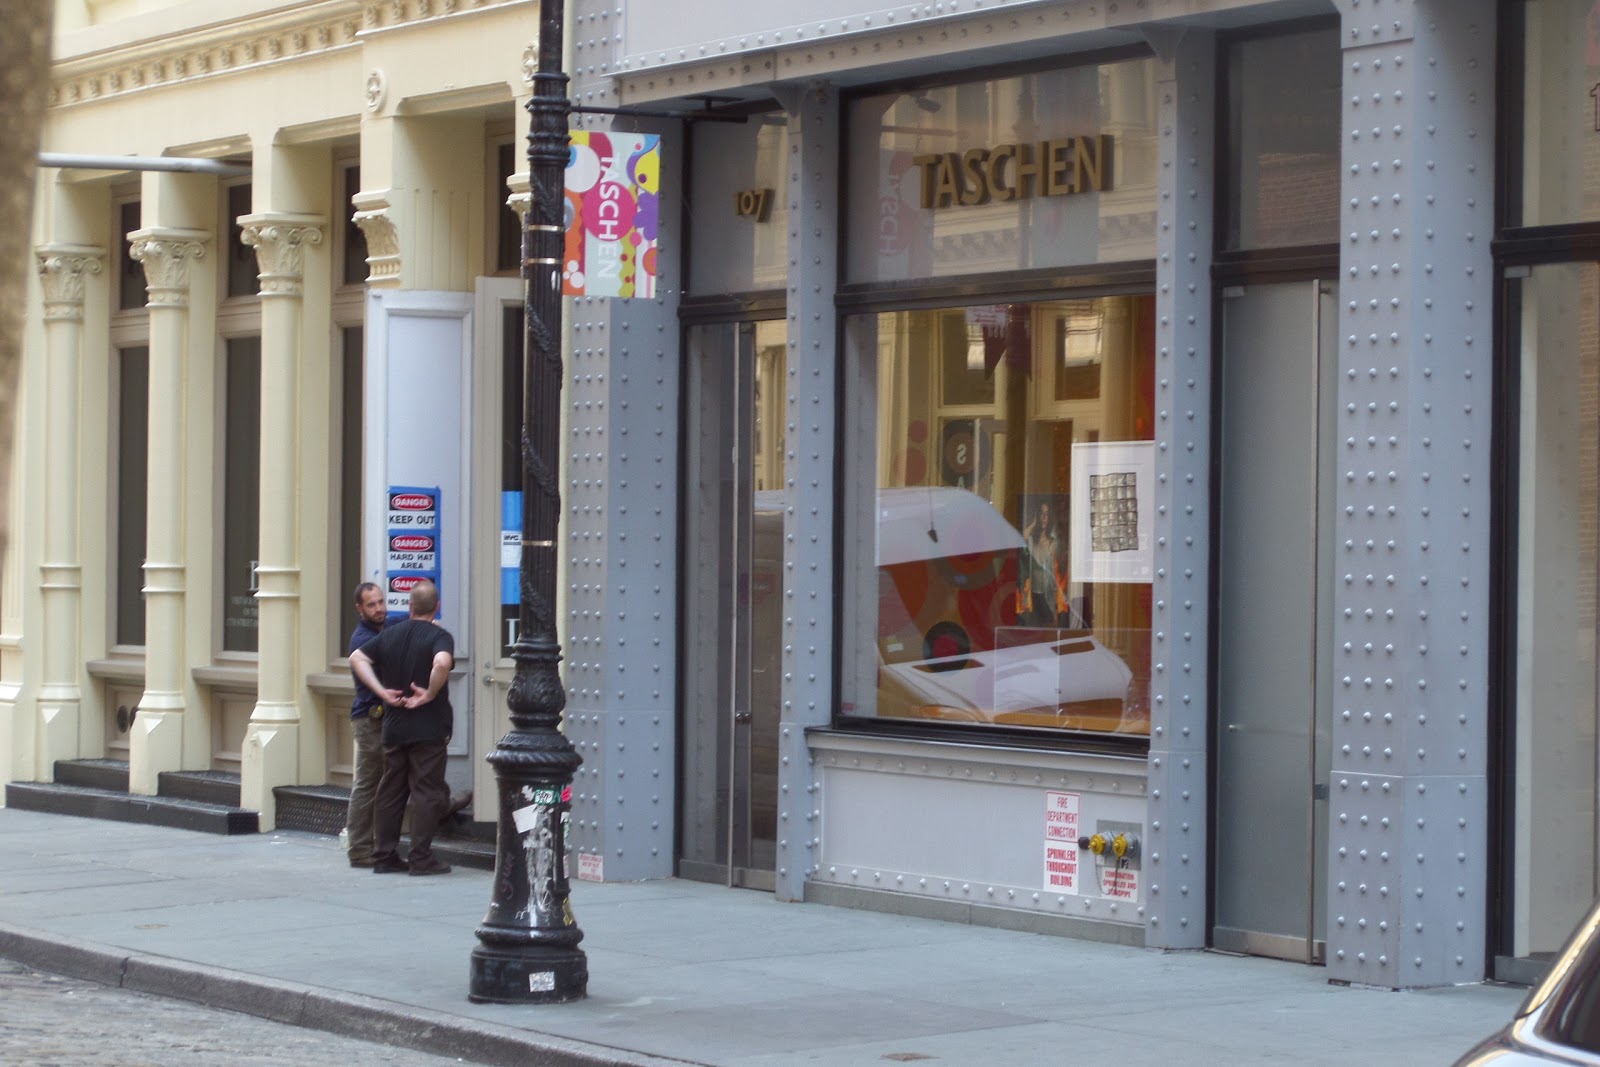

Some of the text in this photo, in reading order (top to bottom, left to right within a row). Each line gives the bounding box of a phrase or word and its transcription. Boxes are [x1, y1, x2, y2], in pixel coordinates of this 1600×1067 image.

[913, 134, 1114, 209] TASCHEN
[598, 157, 620, 278] TASCHEN
[394, 498, 430, 506] DANGER
[389, 515, 435, 524] KEEP OUT
[394, 539, 430, 547] DANGER
[1057, 797, 1068, 808] FIRE
[1047, 810, 1078, 823] DEPARTMENT
[1048, 825, 1076, 838] CONNECTION
[1047, 848, 1076, 861] SPRINKLERS
[1046, 861, 1077, 874] THROUGHOUT
[1050, 874, 1073, 887] BUILDING
